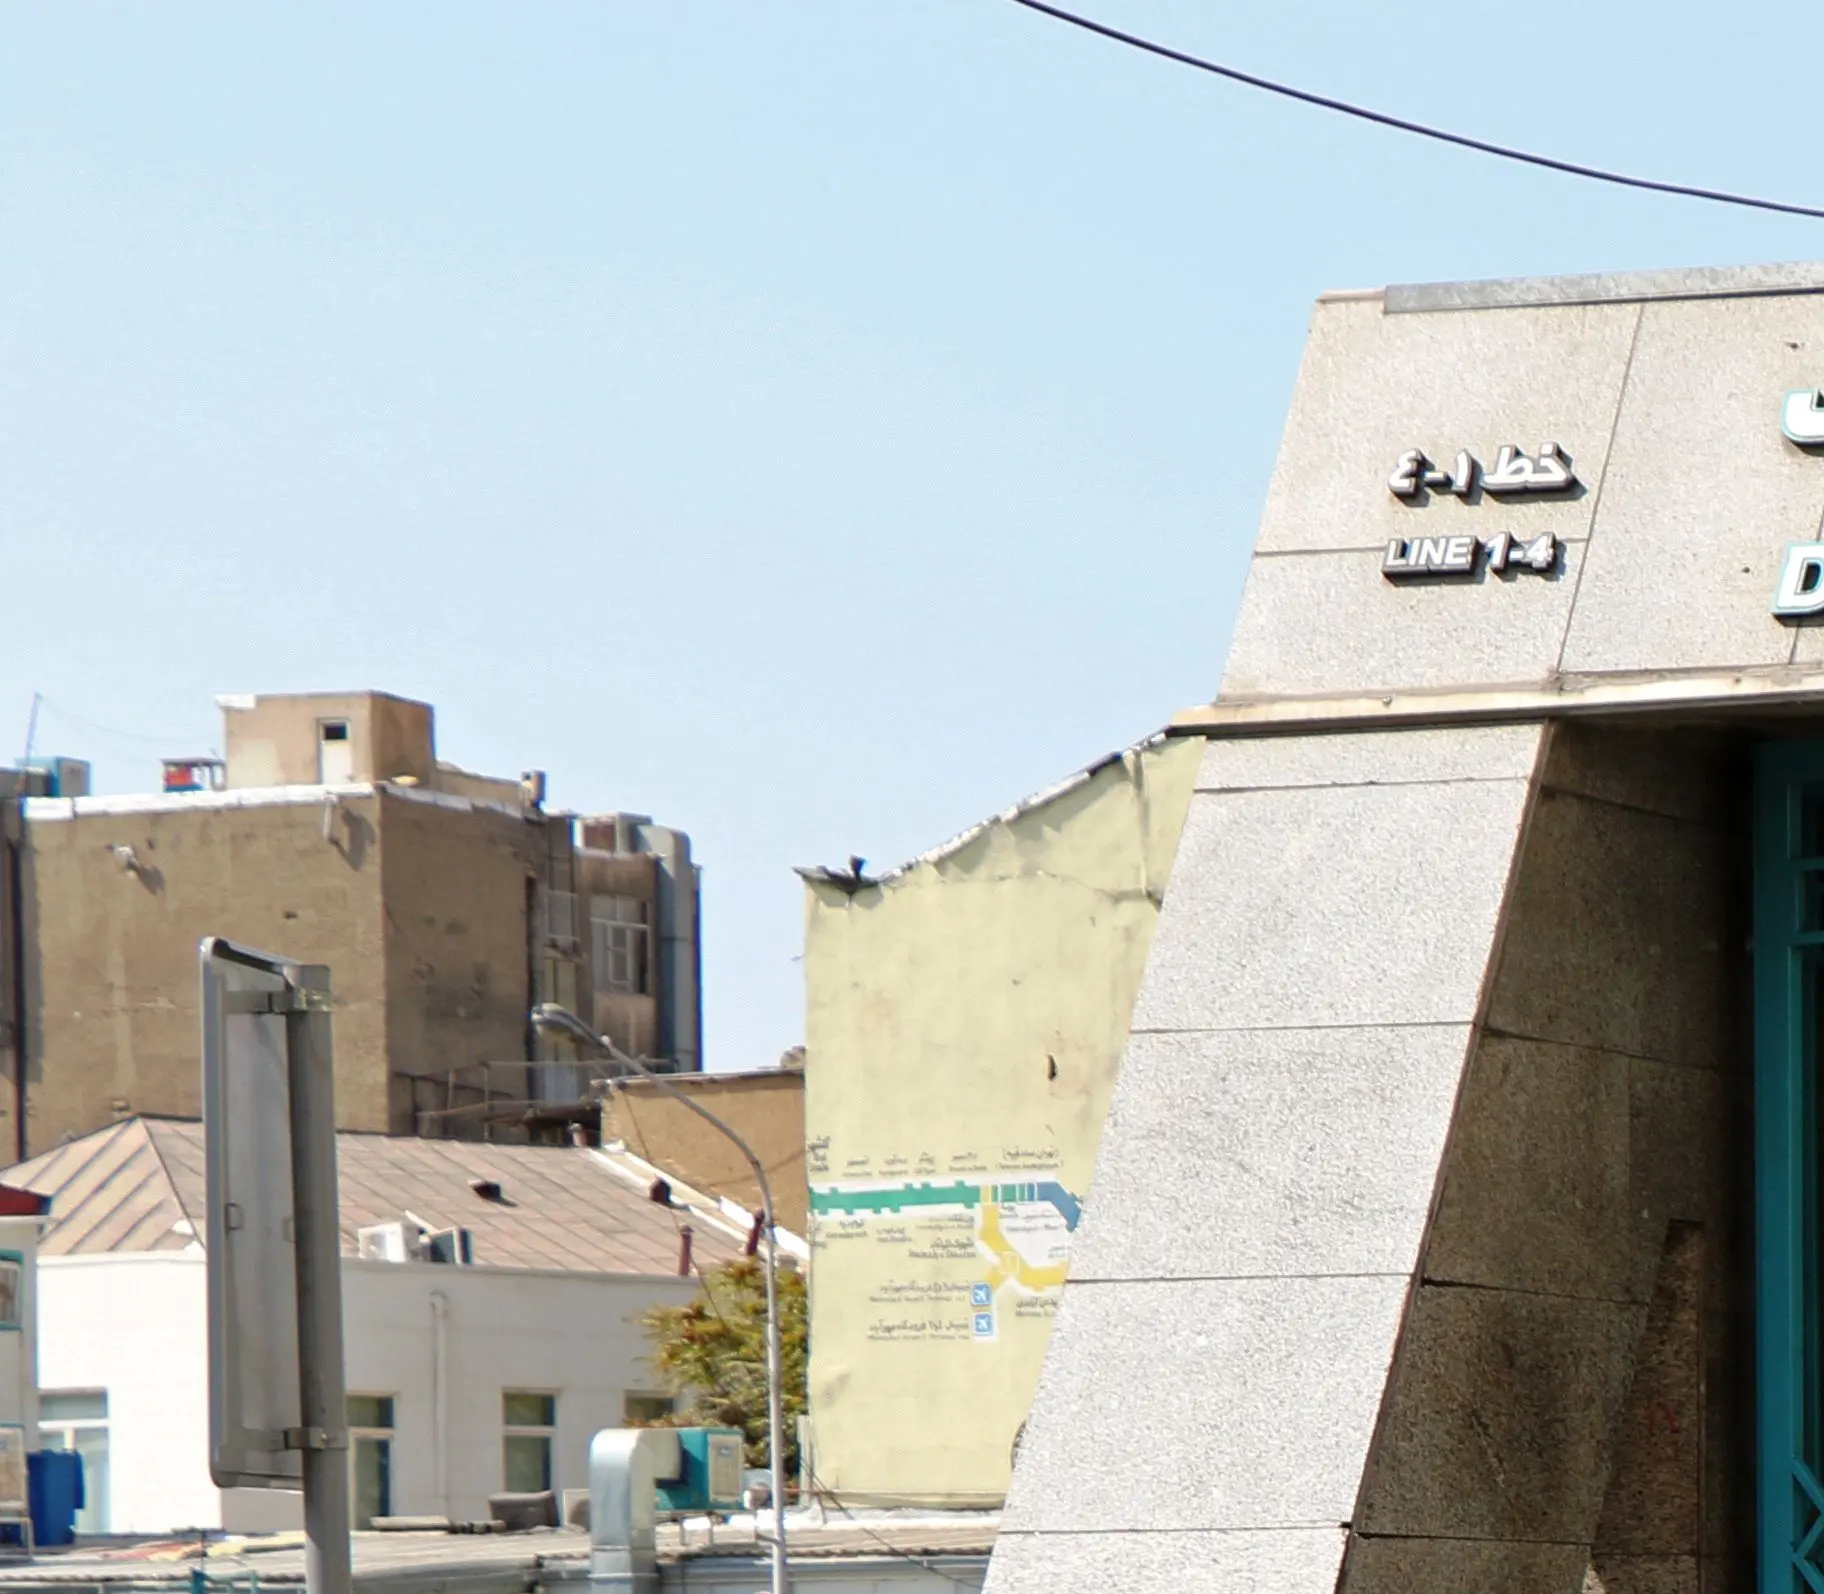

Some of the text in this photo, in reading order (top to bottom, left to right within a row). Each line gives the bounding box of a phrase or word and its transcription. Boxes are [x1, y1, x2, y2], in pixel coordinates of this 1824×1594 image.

[1480, 441, 1574, 495] خط
[1383, 531, 1557, 574] LINE 1-4
